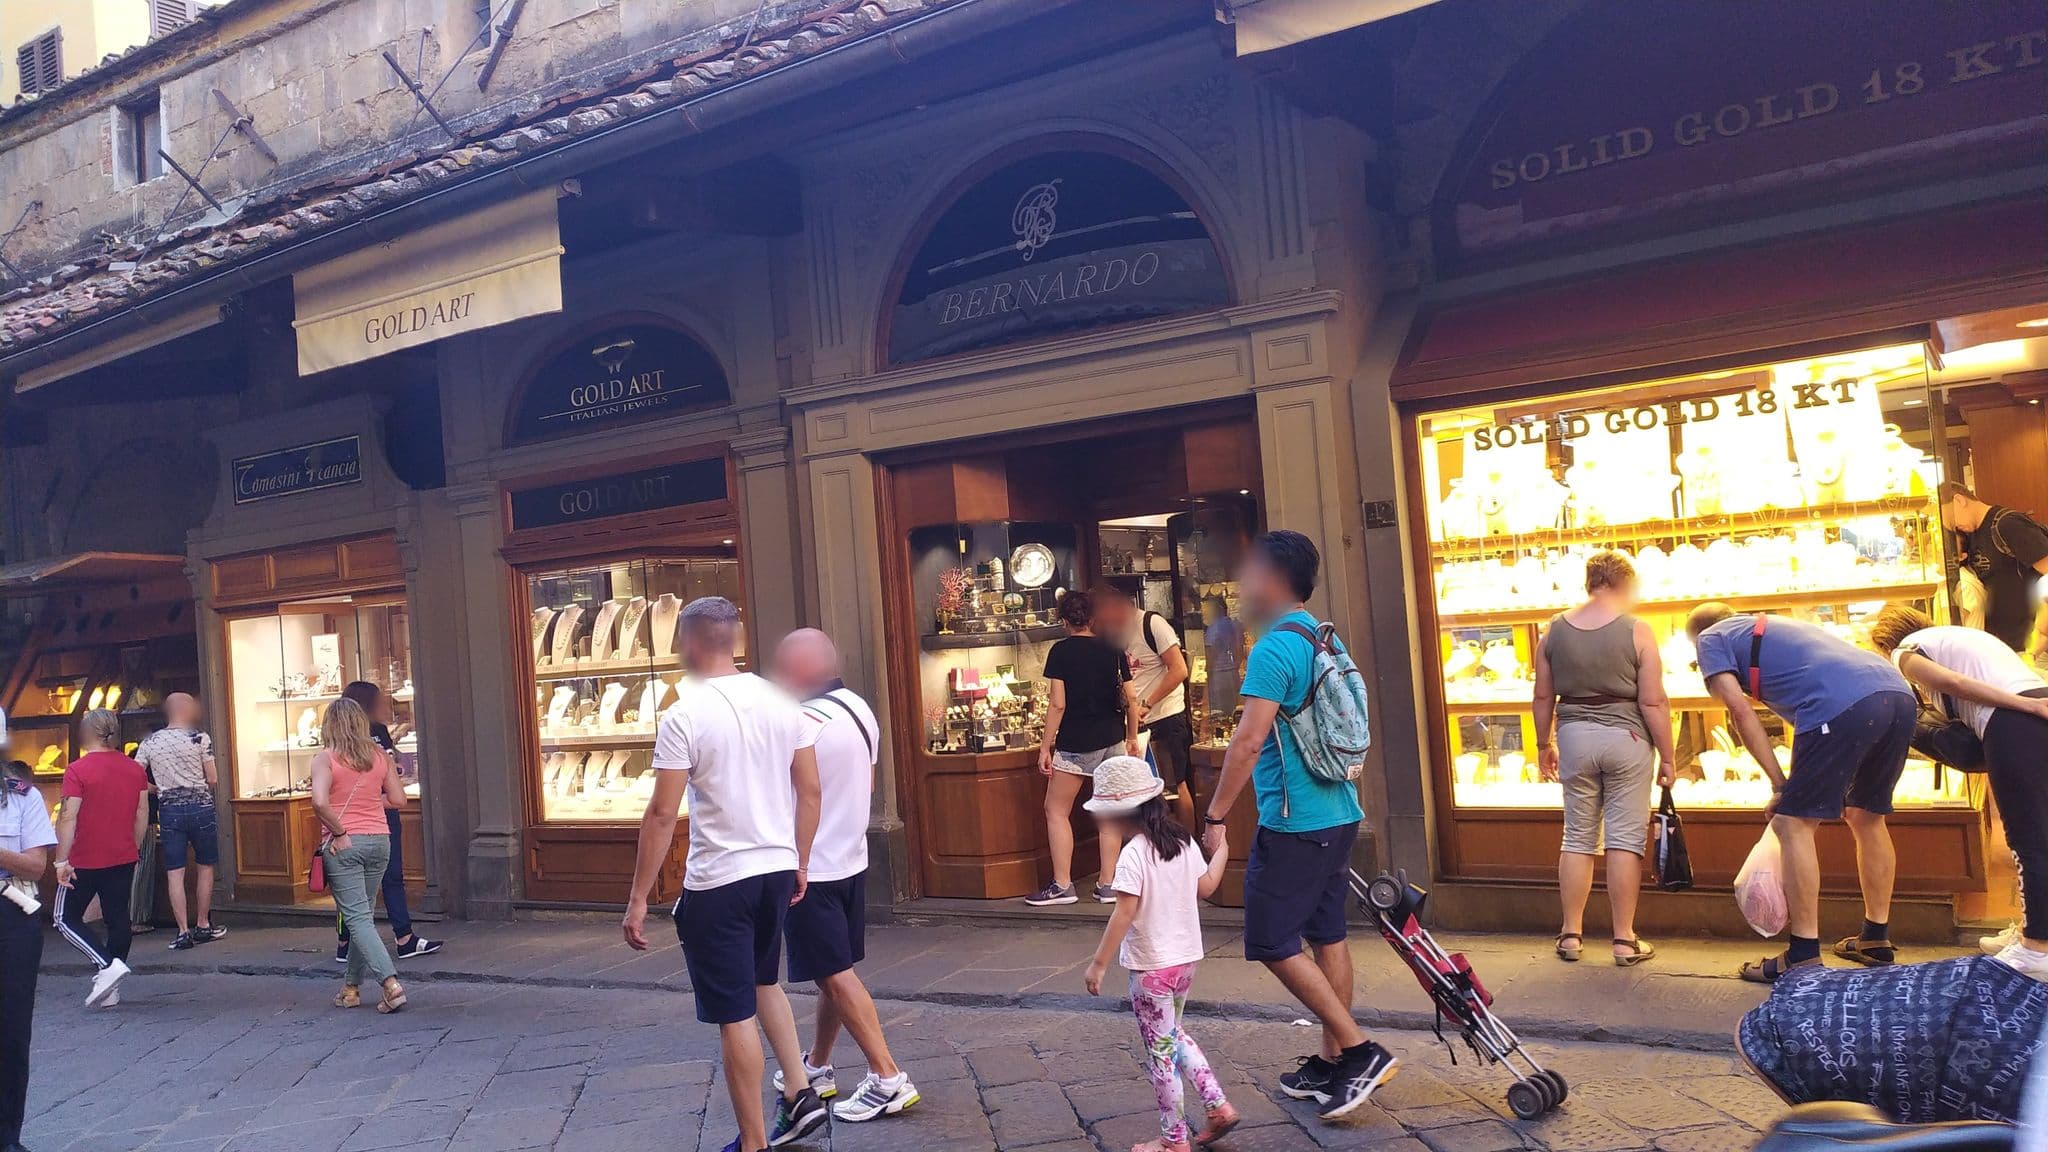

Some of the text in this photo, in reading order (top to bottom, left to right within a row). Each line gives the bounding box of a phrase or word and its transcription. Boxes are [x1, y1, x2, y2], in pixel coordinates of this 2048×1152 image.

[1491, 31, 2048, 190] SOLID GOLD 18 KT
[365, 292, 475, 344] GOLD ART
[939, 252, 1160, 325] BERNARDO
[569, 396, 668, 422] ITALIAN JEWELS
[570, 370, 665, 407] GOLD ART
[1473, 377, 1859, 451] SOLID GOLD 18 KT
[237, 464, 300, 495] Tomasini
[559, 475, 672, 515] GOLD ART
[1839, 973, 1873, 1067] REBELLIOUS
[1973, 979, 2002, 1040] RESPECT
[1797, 1017, 1848, 1083] RESPECT
